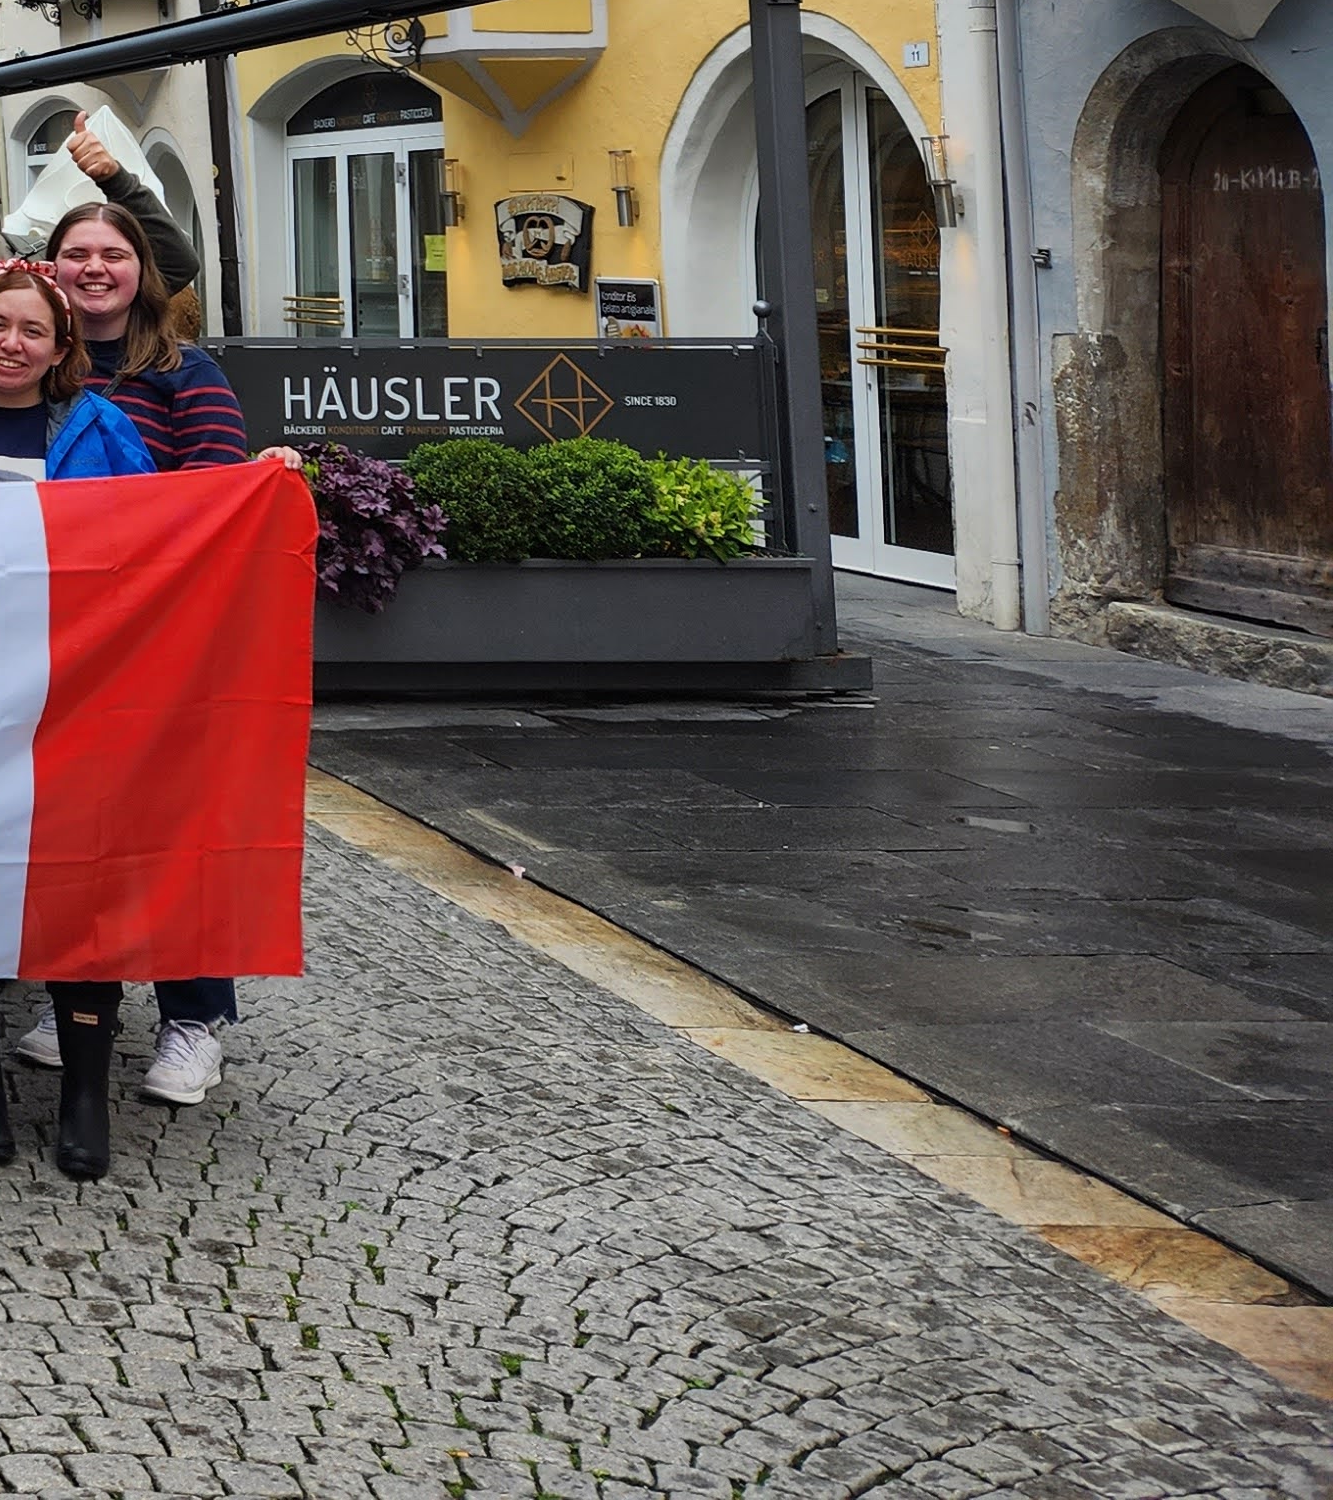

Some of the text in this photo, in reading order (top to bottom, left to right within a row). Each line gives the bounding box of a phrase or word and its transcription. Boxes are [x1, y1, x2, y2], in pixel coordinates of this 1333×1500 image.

[911, 51, 920, 61] 11
[627, 291, 637, 302] Eis
[284, 366, 502, 420] HÄUSLER
[624, 395, 677, 406] SINCE 1830
[283, 424, 505, 436] BÄCKEREI KONDITOREI CAFE PANIFICIO PASTICCERIA
